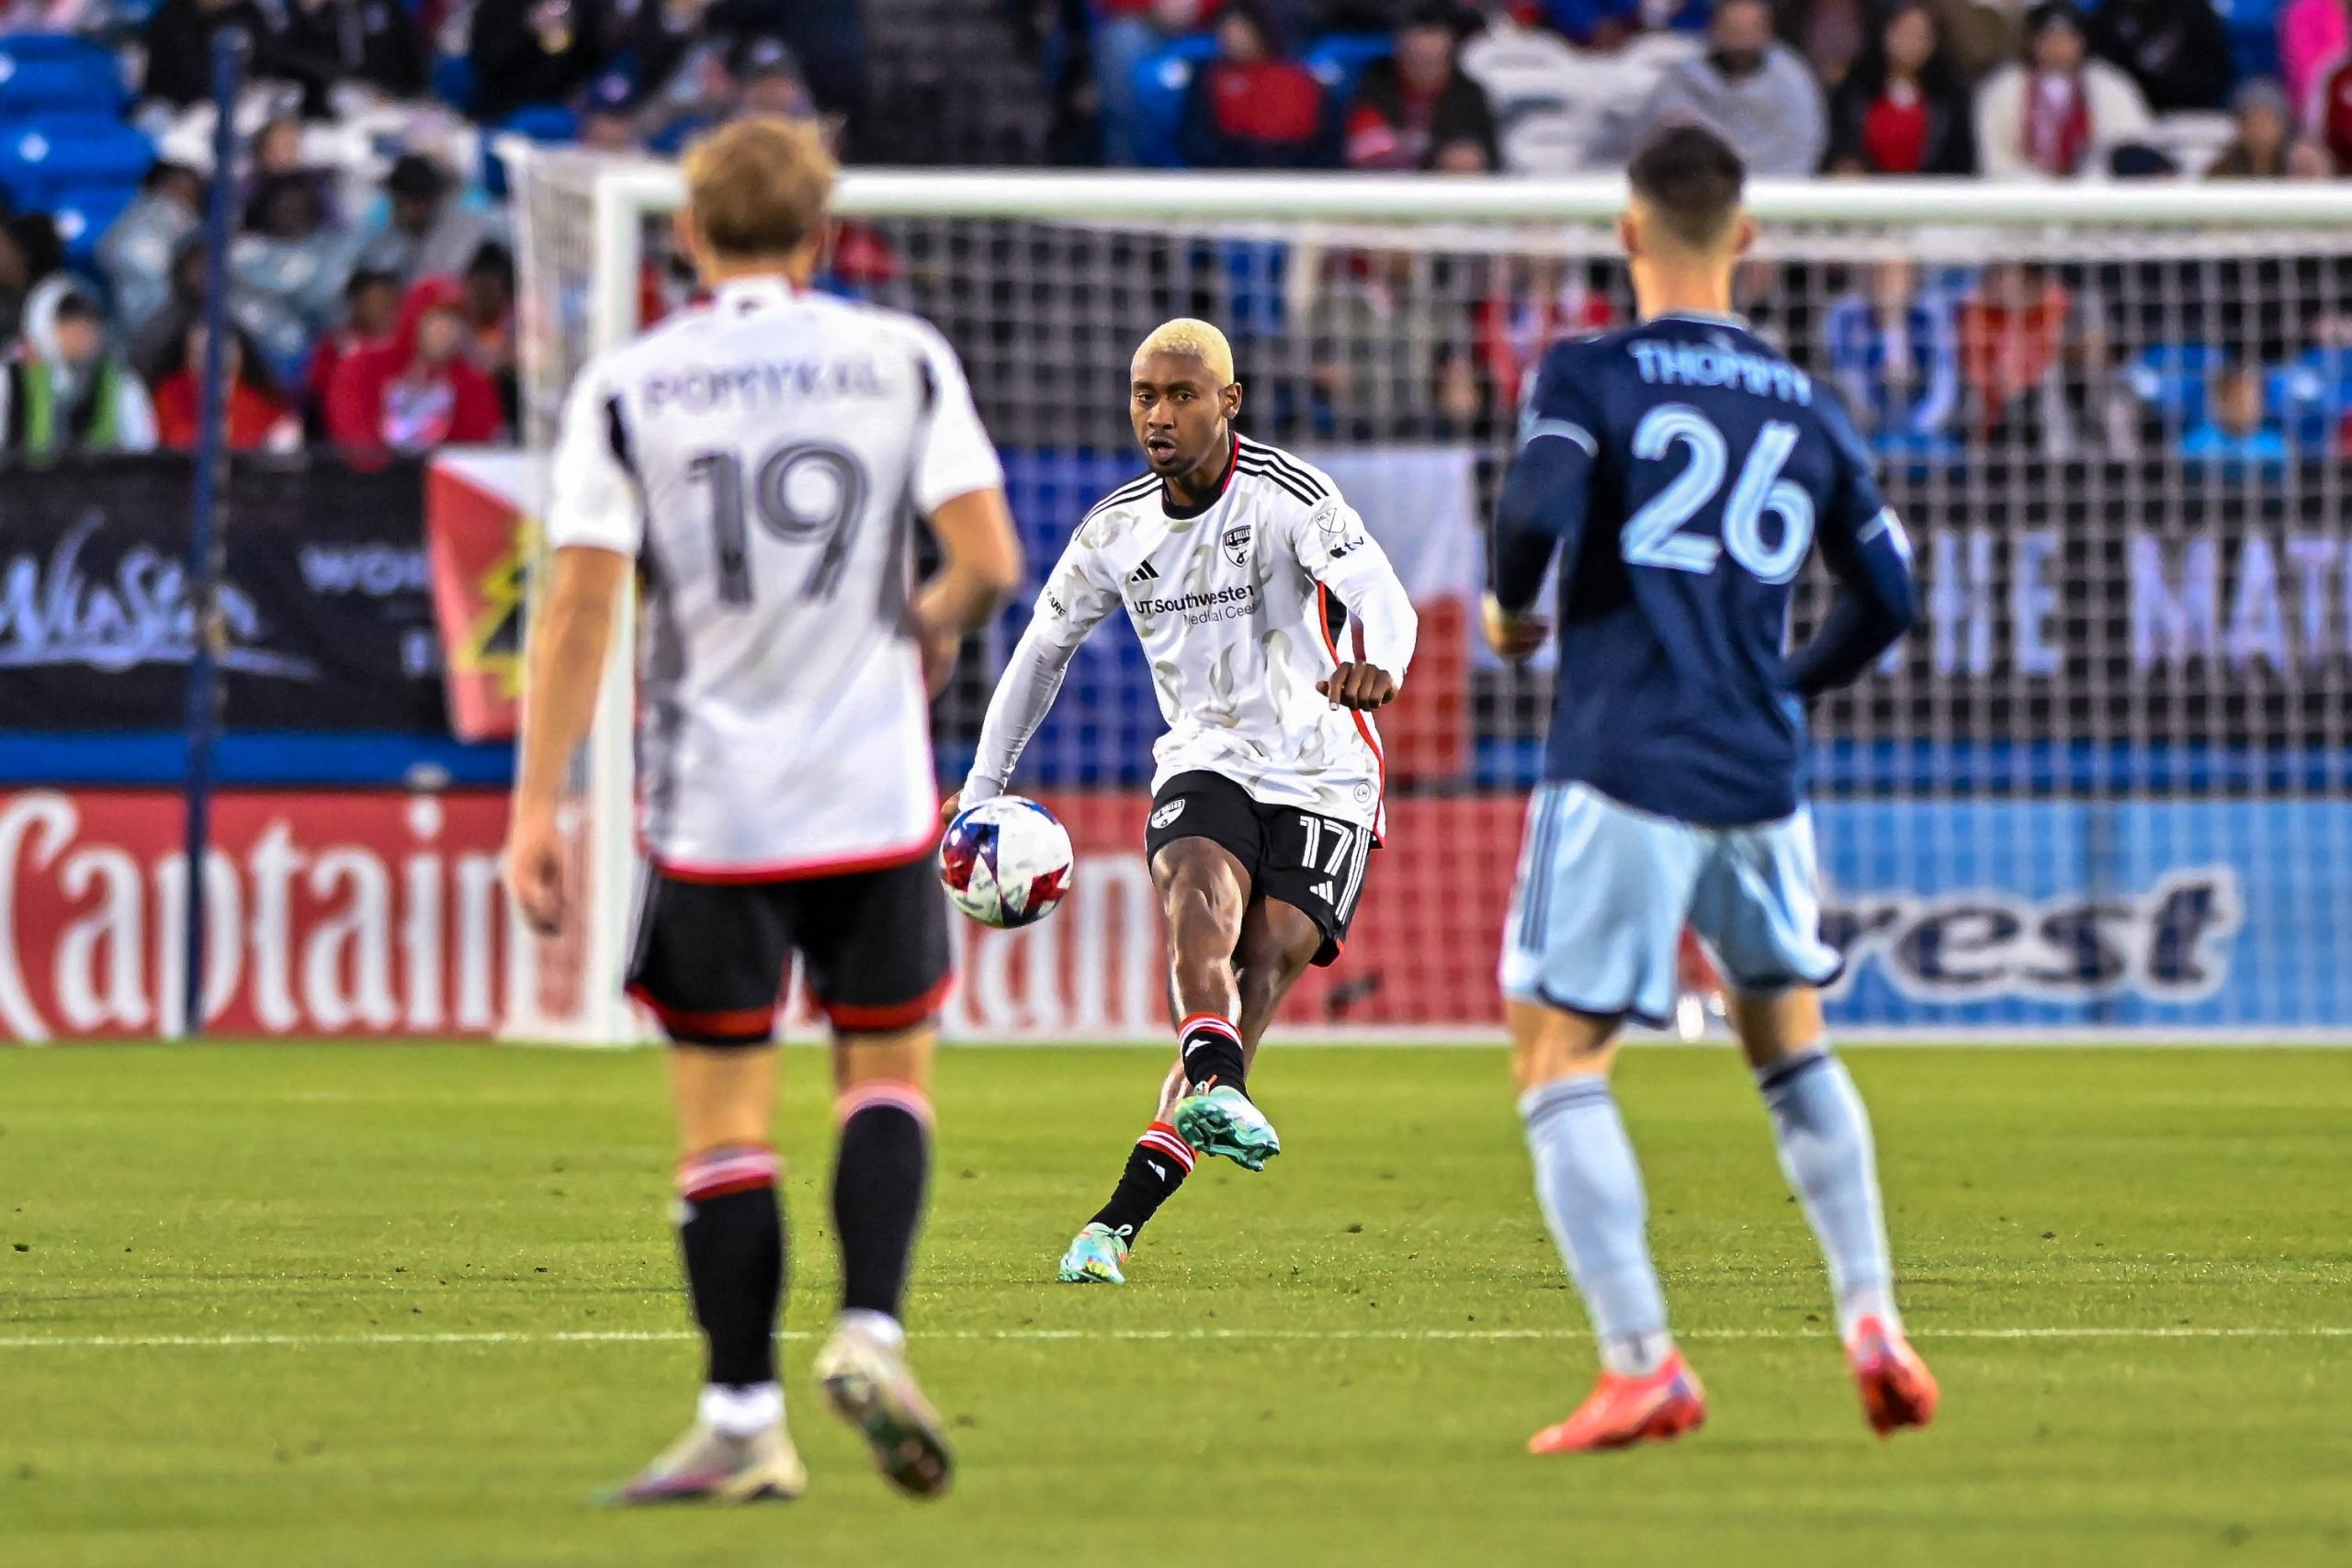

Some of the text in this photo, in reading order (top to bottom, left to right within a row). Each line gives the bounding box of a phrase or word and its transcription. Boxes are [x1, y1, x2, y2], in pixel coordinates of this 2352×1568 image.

[690, 440, 868, 610] 19
[1344, 536, 1364, 551] tv
[1620, 402, 1815, 585] 26
[1881, 531, 2352, 673] HE MAT
[1300, 815, 1353, 876] 17
[1813, 873, 2234, 994] rest
